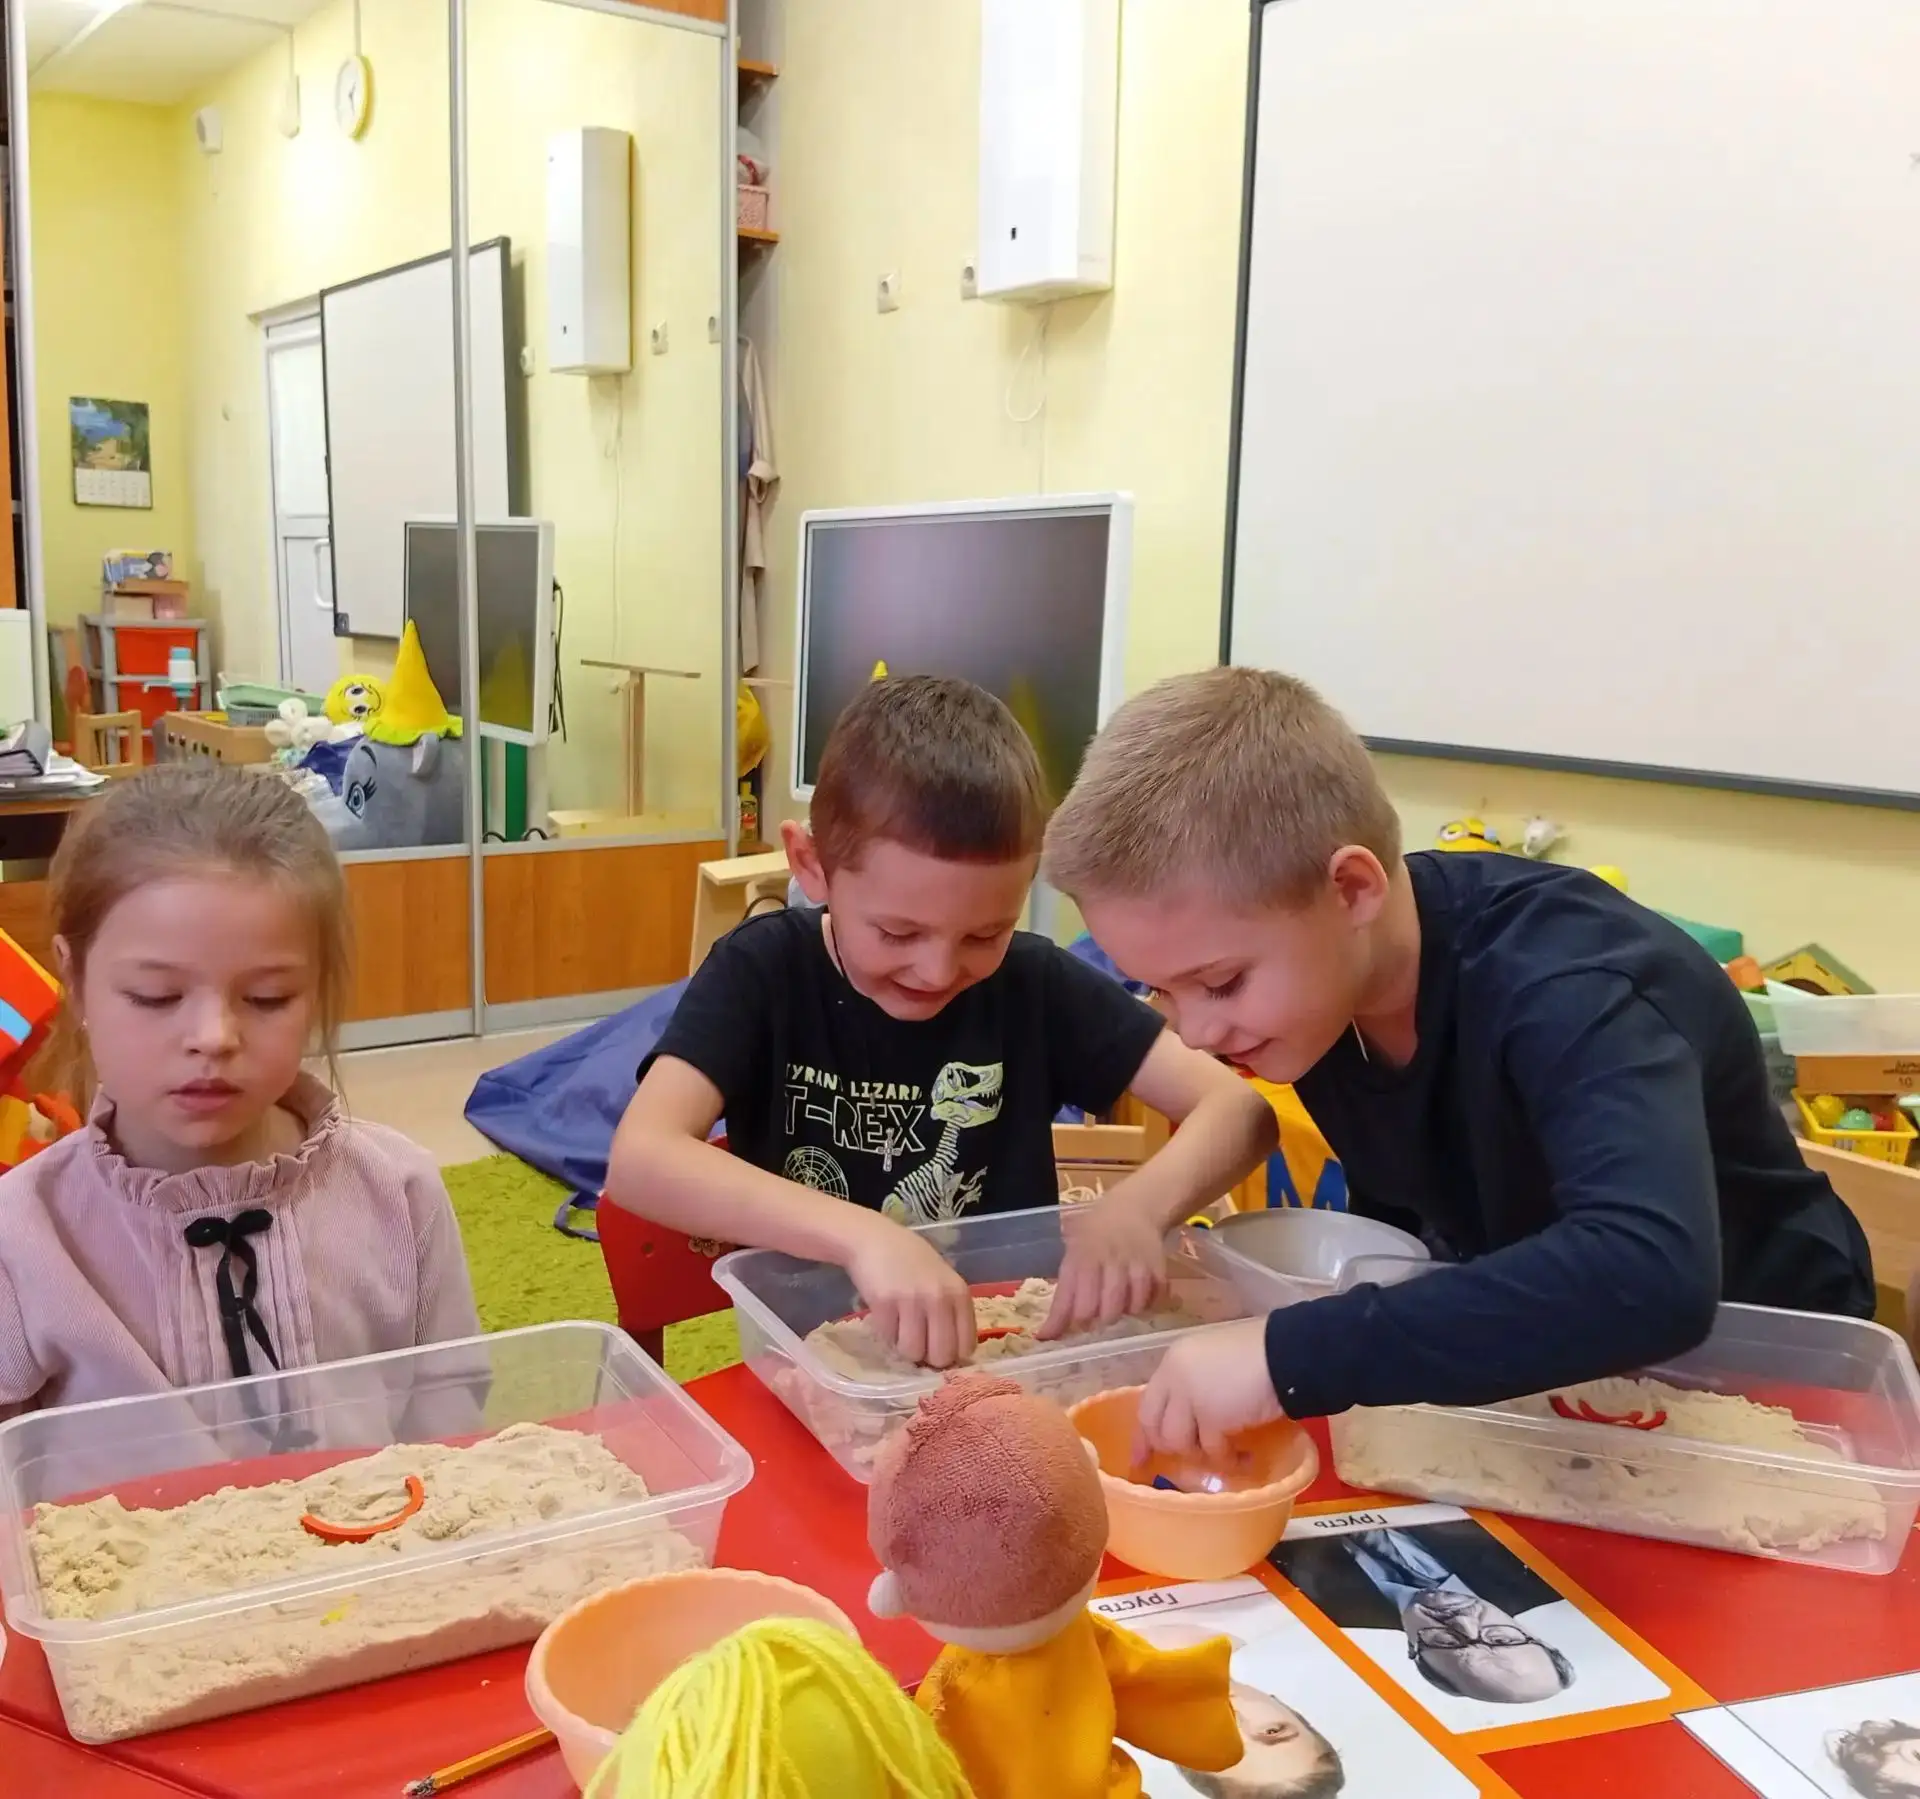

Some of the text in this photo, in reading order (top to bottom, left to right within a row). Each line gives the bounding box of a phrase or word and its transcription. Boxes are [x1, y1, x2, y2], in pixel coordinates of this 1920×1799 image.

[784, 1084, 926, 1153] T-REX
[1314, 1513, 1388, 1528] Грусть
[1098, 1592, 1179, 1613] Грусть
